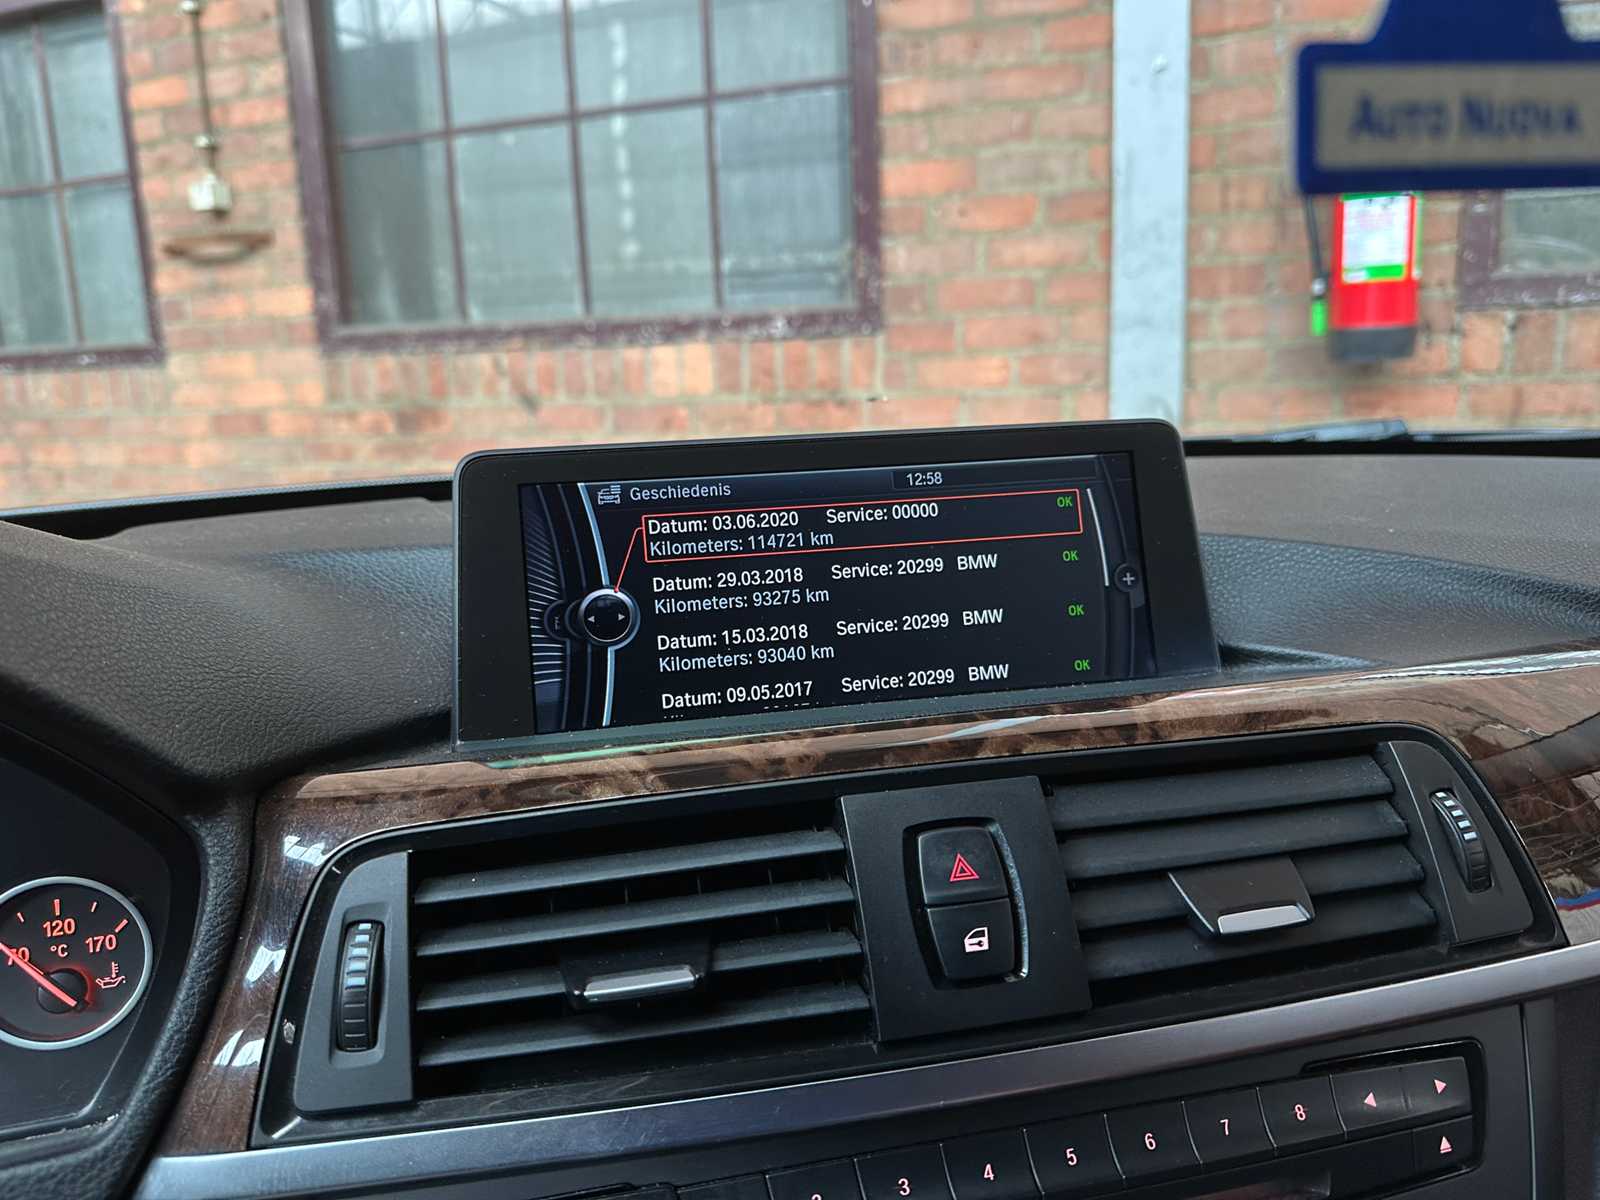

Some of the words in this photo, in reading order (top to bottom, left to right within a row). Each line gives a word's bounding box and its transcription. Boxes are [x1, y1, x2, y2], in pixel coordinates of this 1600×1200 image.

[907, 472, 942, 485] 12:58
[630, 483, 731, 500] Geschiedenis
[1057, 497, 1072, 507] OK
[648, 520, 707, 534] Datum:
[713, 511, 798, 530] 03.06.2020
[827, 507, 887, 523] Service:
[892, 503, 938, 519] 00000
[650, 539, 743, 556] Kilometers:
[748, 533, 803, 549] 114721
[811, 532, 833, 545] km
[1063, 551, 1078, 561] OK
[653, 577, 712, 592] Datum:
[717, 568, 803, 587] 29.03.2018
[832, 563, 892, 579] Service:
[897, 558, 943, 574] 20299
[958, 554, 997, 570] BMW
[655, 596, 747, 614] Kilometers:
[753, 589, 800, 606] 93275
[806, 589, 829, 602] km
[1069, 605, 1084, 615] OK
[658, 634, 716, 650] Datum:
[722, 624, 808, 644] 15.03.2018
[837, 619, 898, 635] Service:
[903, 613, 948, 630] 20299
[963, 608, 1003, 625] BMW
[660, 654, 752, 672] Kilometers:
[758, 646, 806, 663] 93040
[811, 645, 834, 659] km
[1075, 660, 1090, 670] OK
[662, 692, 721, 708] Datum:
[727, 681, 812, 702] 09.05.2017
[842, 675, 903, 692] Service:
[908, 669, 954, 686] 20299
[968, 664, 1008, 681] BMW
[43, 919, 75, 937] 120
[50, 944, 67, 957] °C
[85, 935, 116, 952] 170
[1295, 1104, 1305, 1120] 8
[1220, 1119, 1228, 1135] 7
[1145, 1133, 1155, 1149] 6
[1067, 1148, 1077, 1165] 5
[984, 1164, 994, 1180] 4
[899, 1178, 910, 1195] 3
